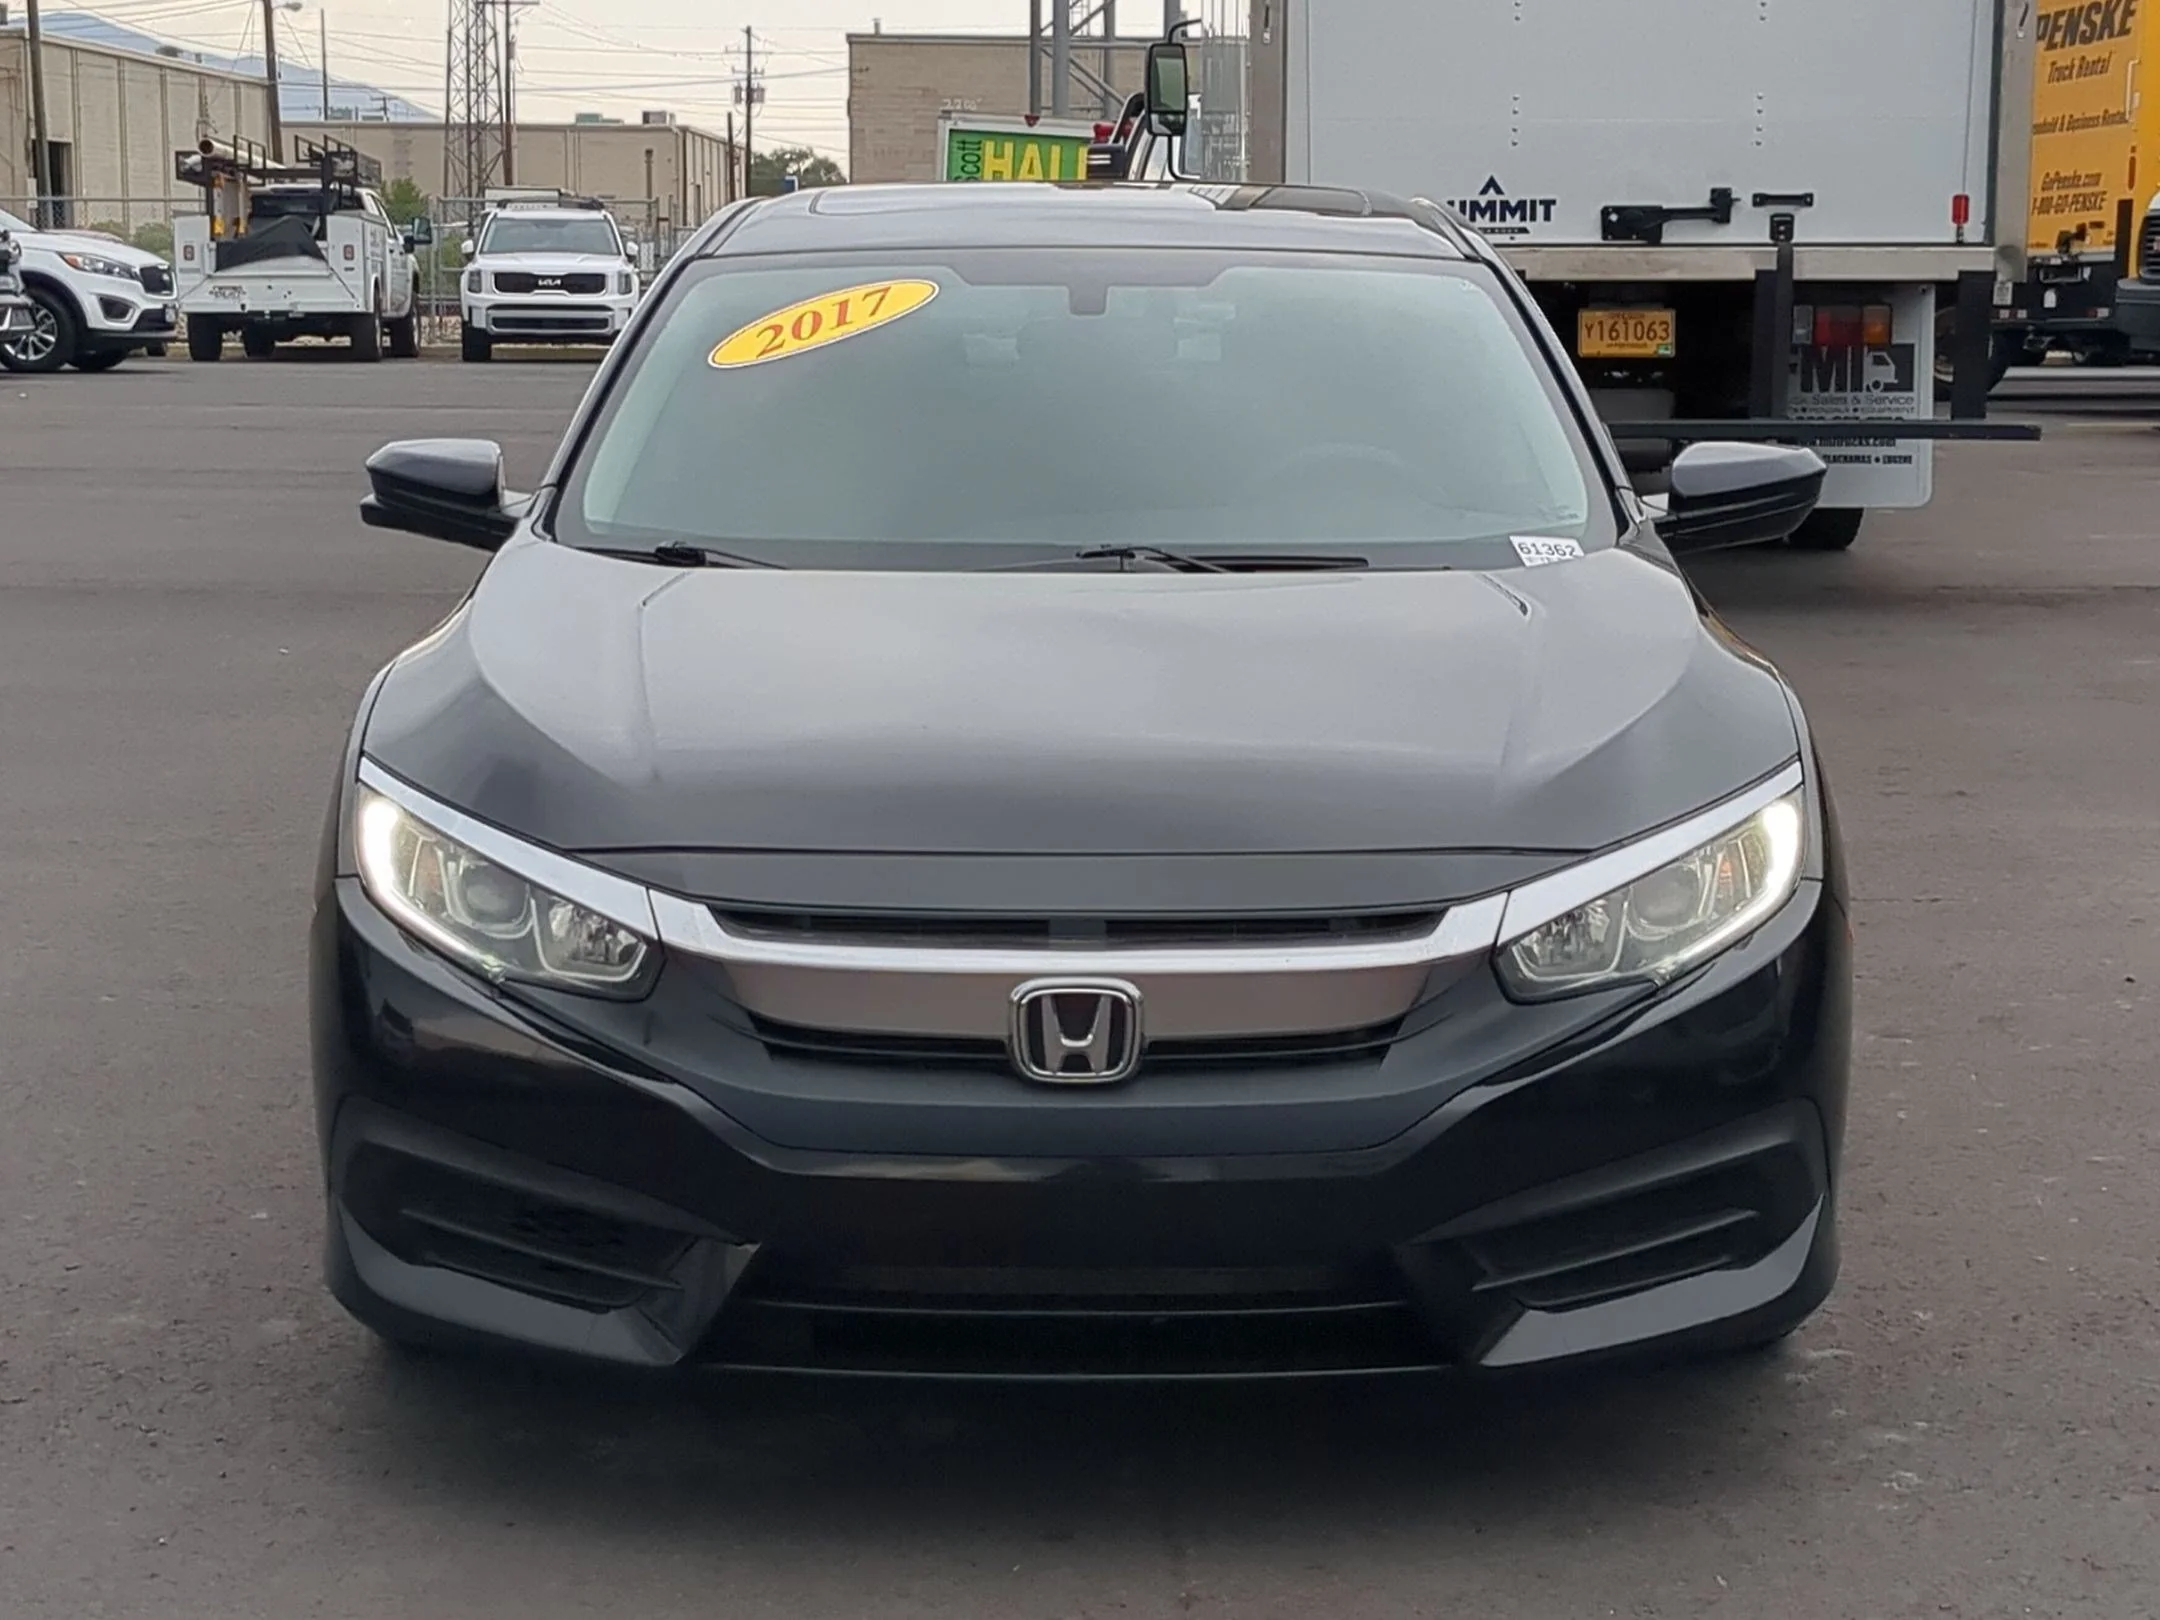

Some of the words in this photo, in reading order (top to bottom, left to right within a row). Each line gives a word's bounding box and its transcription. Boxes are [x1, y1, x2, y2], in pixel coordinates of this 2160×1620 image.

[2037, 0, 2136, 51] PENSKE
[2048, 57, 2076, 84] Truck
[2076, 50, 2112, 79] Rental
[756, 286, 892, 358] 2017
[1584, 320, 1670, 341] Y161063
[1866, 394, 1915, 405] Service
